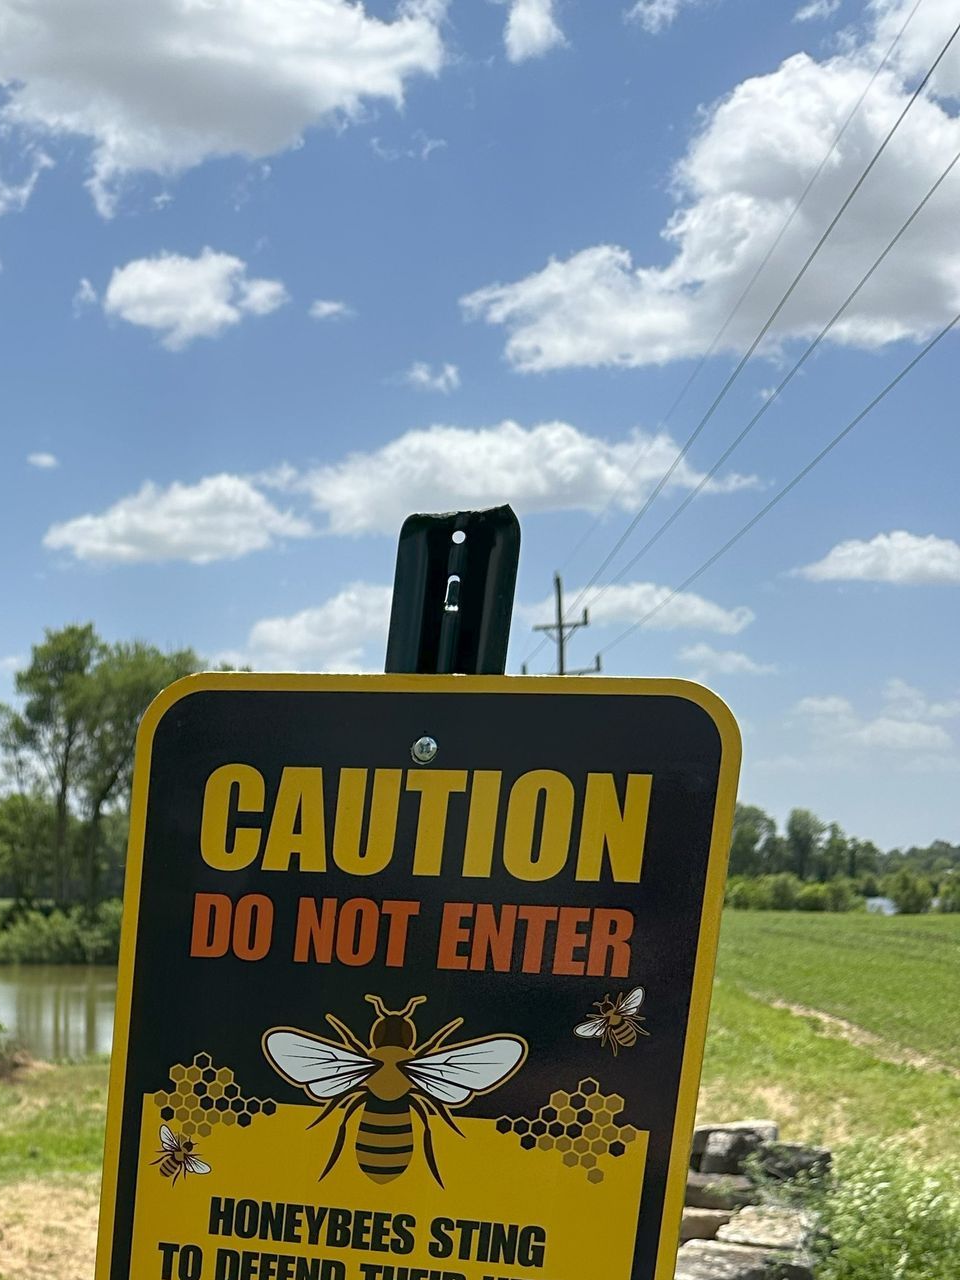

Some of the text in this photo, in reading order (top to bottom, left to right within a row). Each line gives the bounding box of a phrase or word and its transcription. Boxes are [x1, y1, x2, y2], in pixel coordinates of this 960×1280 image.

[200, 763, 653, 883] CAUTION
[189, 893, 635, 979] DO NOT ENTER
[208, 1196, 546, 1268] HONEYBEES STING
